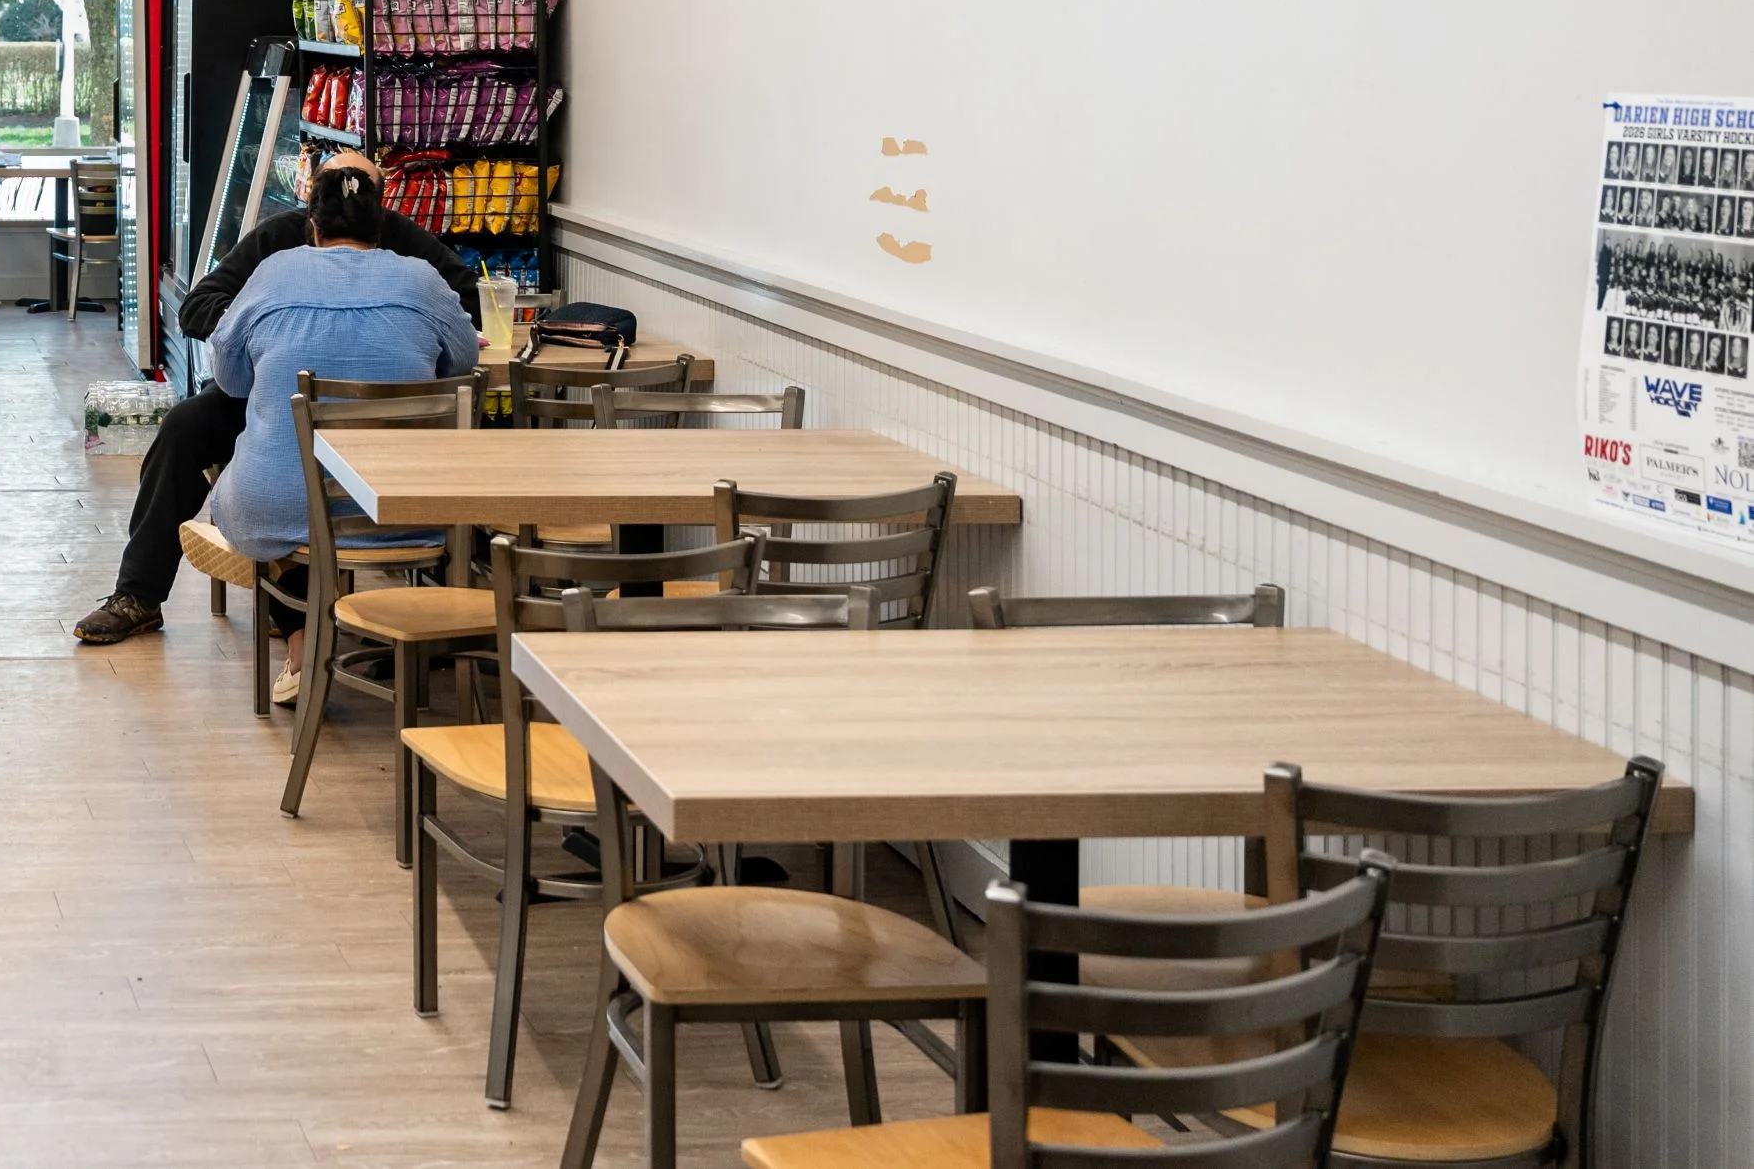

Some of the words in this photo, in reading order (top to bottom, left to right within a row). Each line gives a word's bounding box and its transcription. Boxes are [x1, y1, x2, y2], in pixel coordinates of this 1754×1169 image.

[1614, 106, 1669, 125] DARIEN
[1673, 108, 1711, 127] HIGH
[1646, 127, 1674, 140] GIRLS
[1676, 128, 1721, 144] VARSITY
[1644, 376, 1702, 402] WAVE
[1584, 435, 1632, 466] RIKO'S
[1646, 457, 1699, 477] PALMER'S
